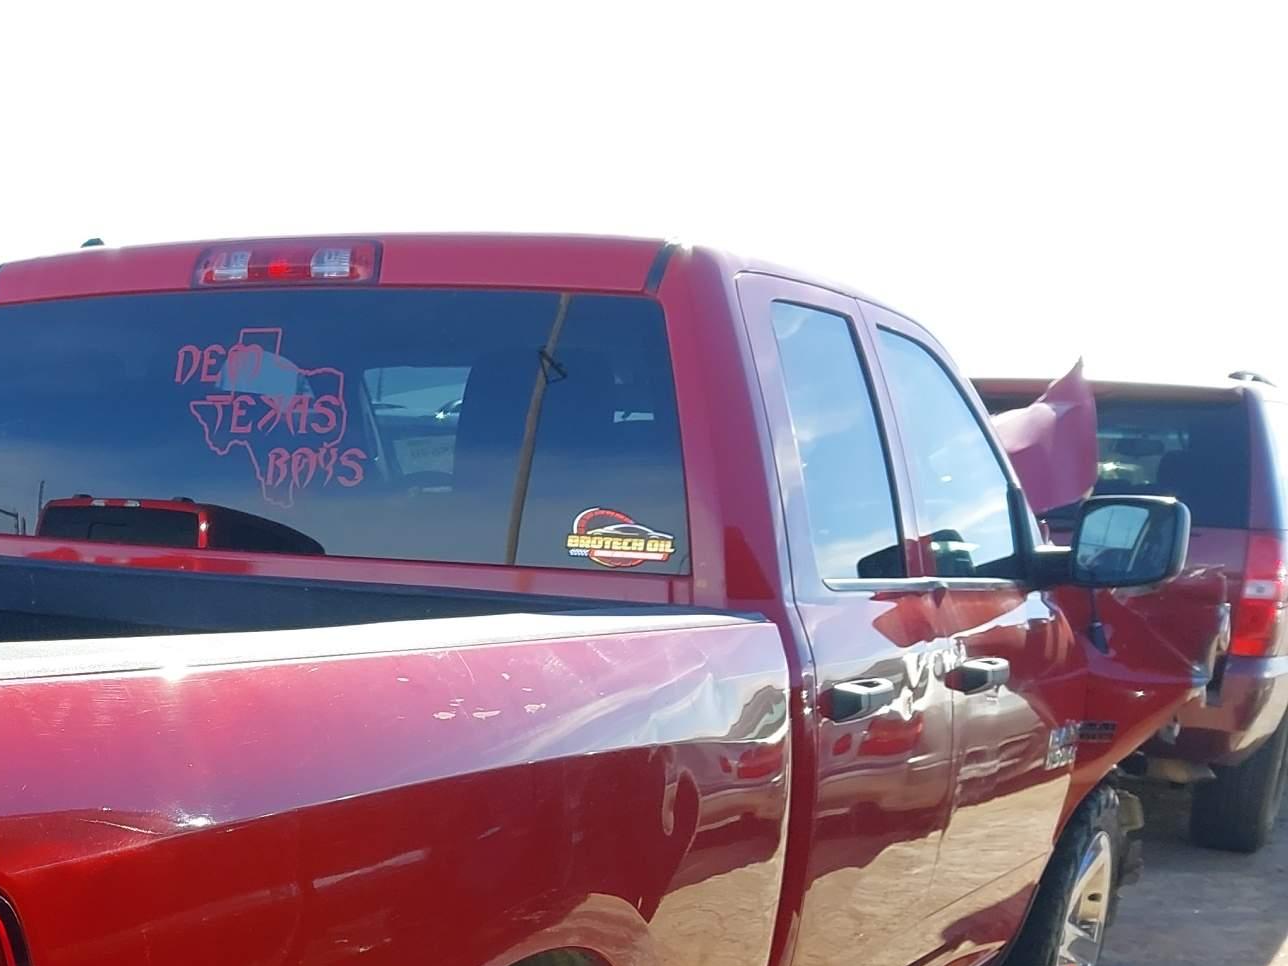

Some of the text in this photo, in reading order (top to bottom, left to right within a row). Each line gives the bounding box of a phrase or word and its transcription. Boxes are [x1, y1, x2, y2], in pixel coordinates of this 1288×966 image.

[174, 344, 264, 385] DEM
[205, 395, 340, 437] TEXAS
[265, 447, 368, 488] BOYS
[567, 535, 675, 553] BROTECH OIL
